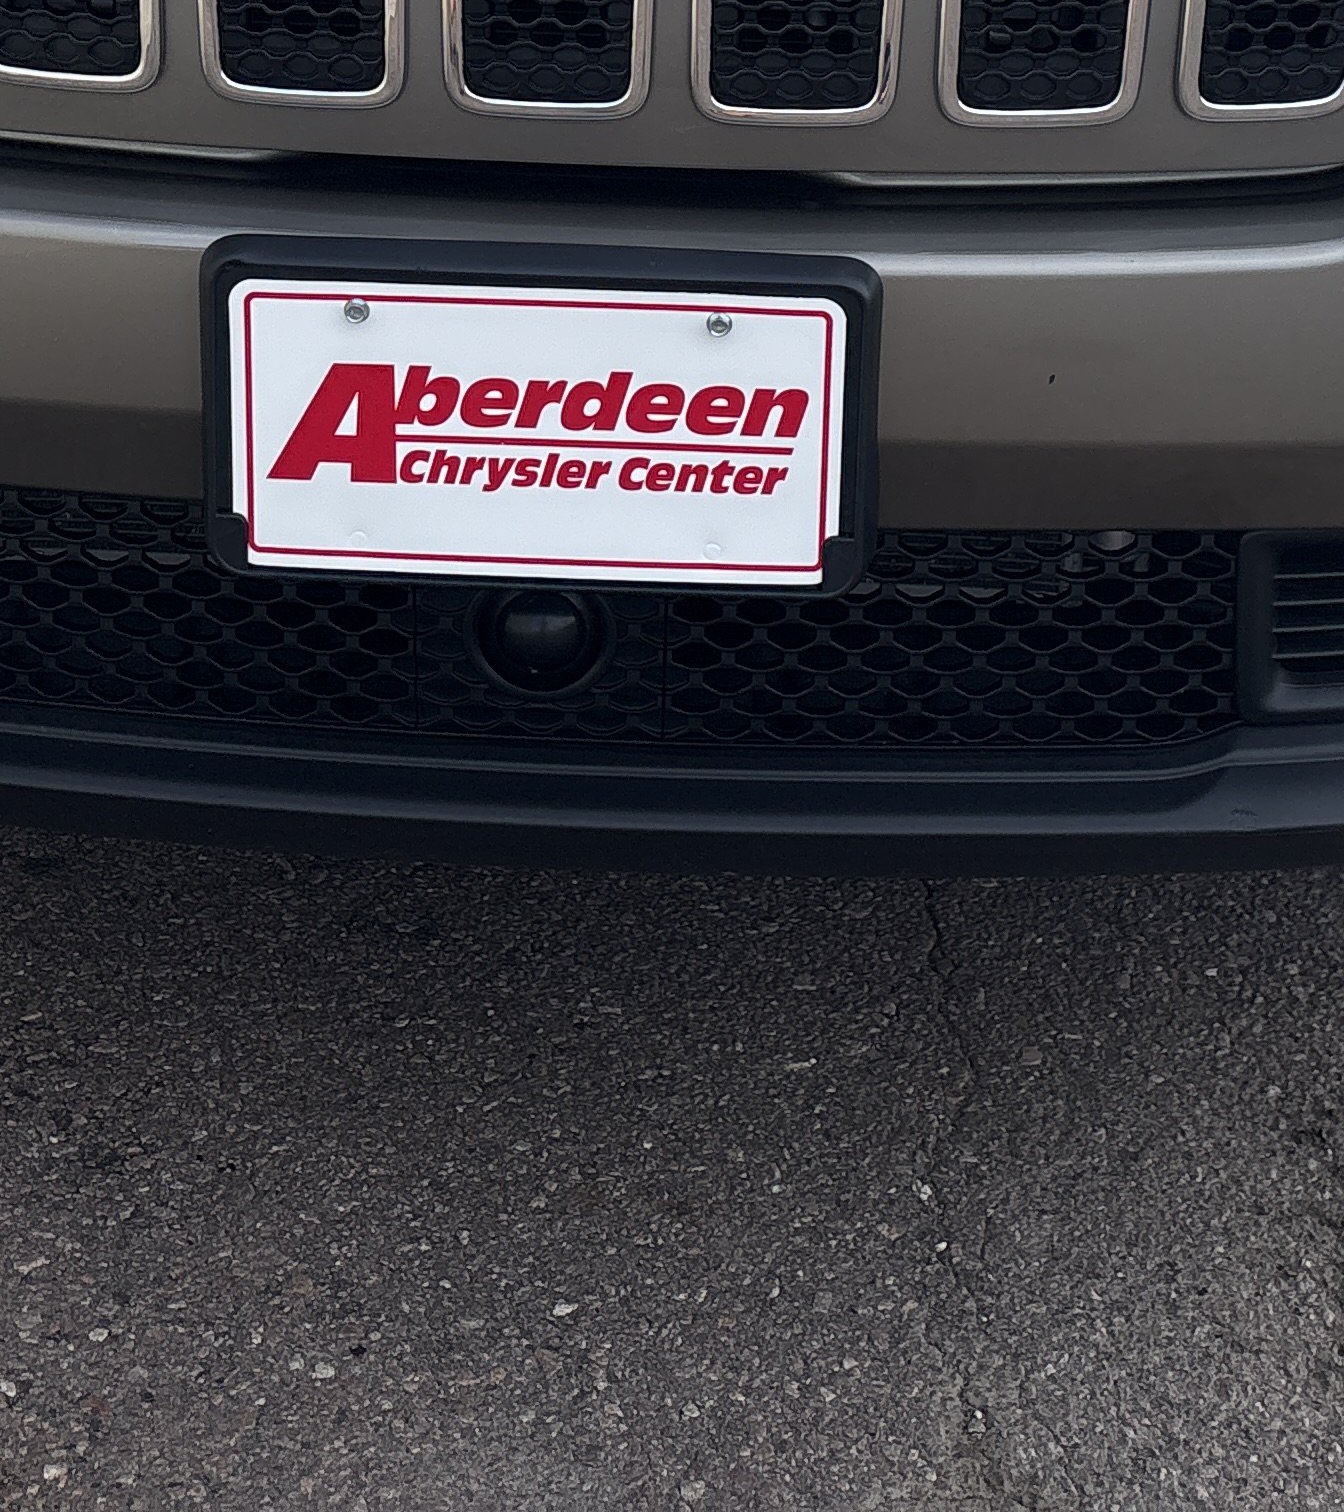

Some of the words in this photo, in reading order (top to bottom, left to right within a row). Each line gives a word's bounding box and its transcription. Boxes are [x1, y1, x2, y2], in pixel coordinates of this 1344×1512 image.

[266, 362, 810, 484] Aberdeen
[398, 448, 612, 493] Chrysler
[618, 456, 789, 496] Center
